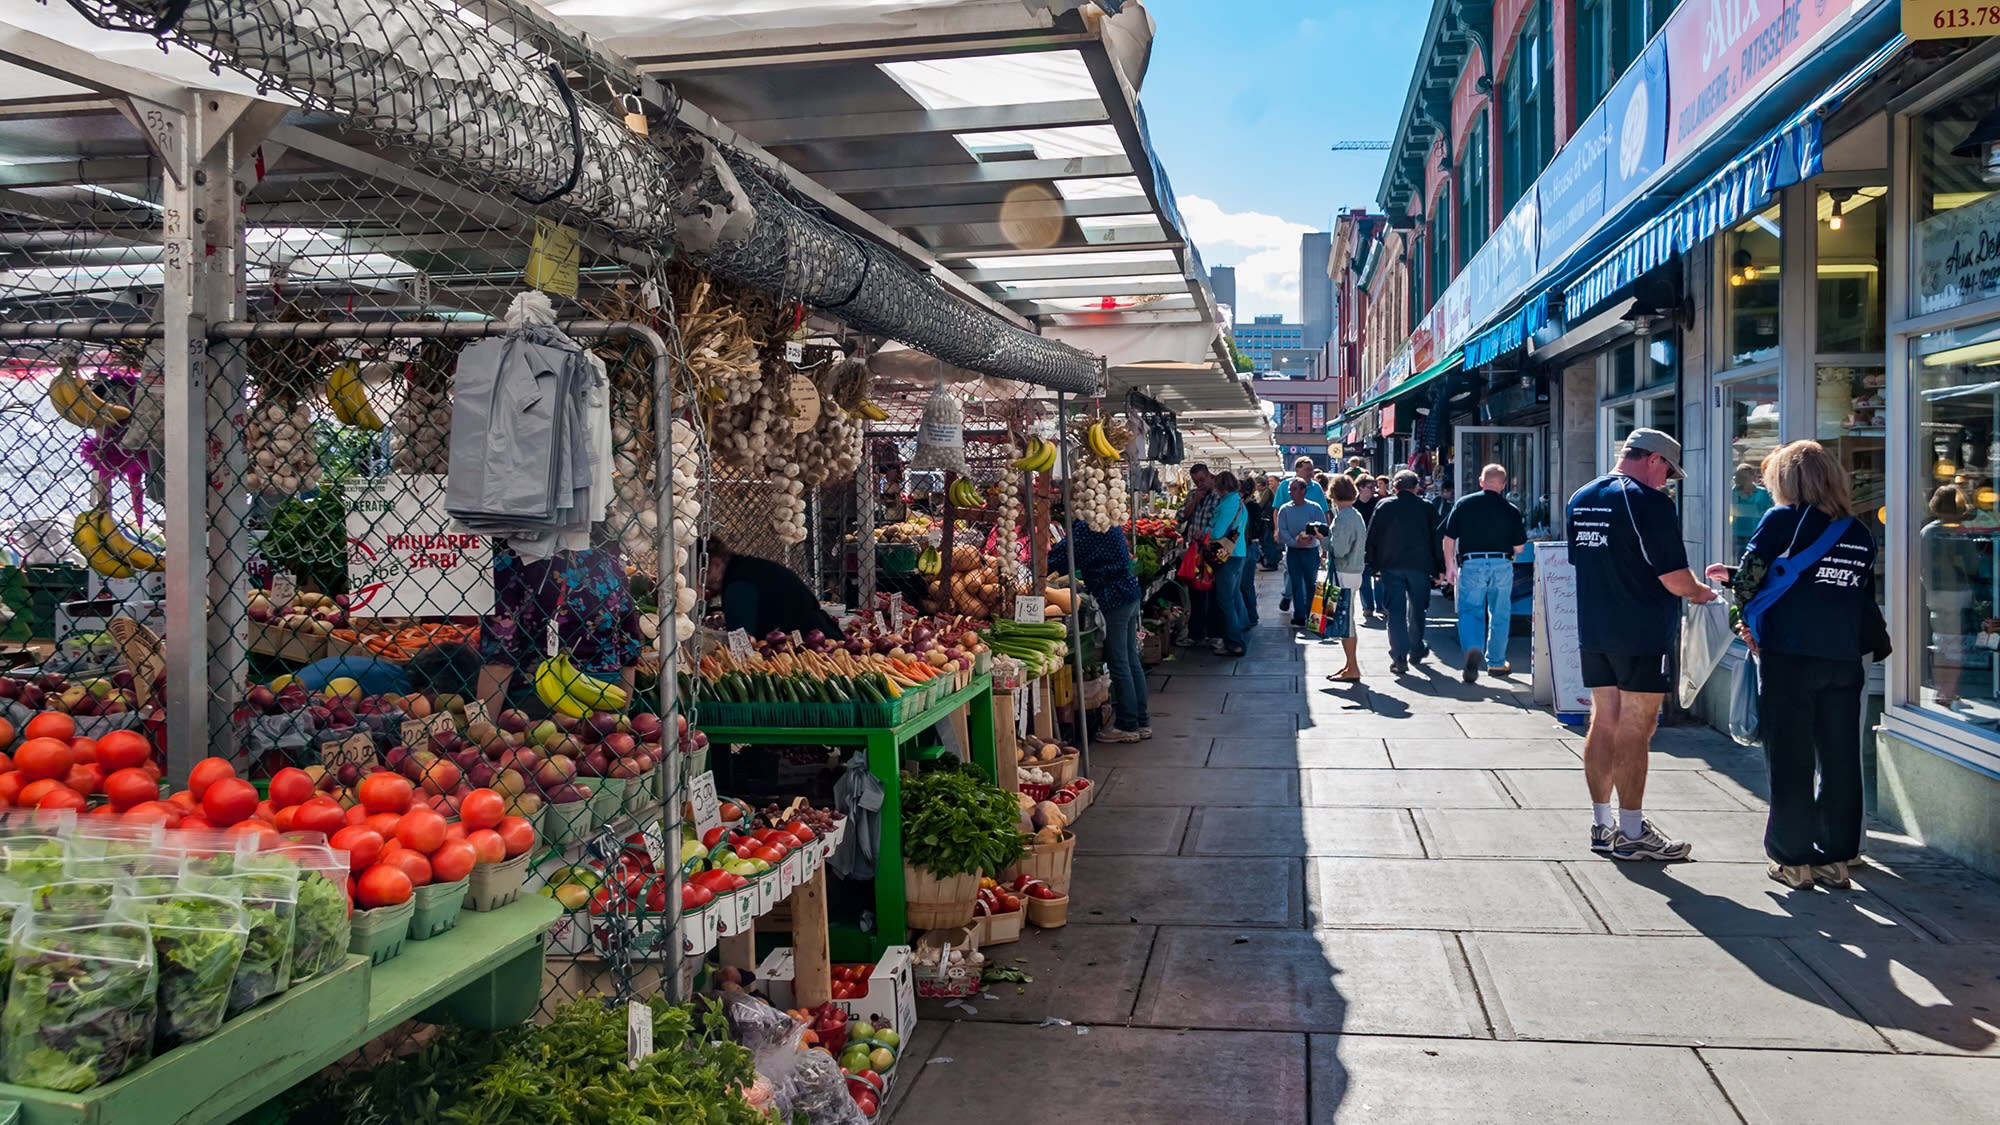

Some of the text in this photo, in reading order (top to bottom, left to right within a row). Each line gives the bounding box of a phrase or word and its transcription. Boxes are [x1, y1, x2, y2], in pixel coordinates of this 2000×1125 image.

[1678, 65, 1730, 145] BOULANGERIE
[1740, 2, 1801, 88] PATISSERIE
[147, 111, 164, 131] 53
[1553, 175, 1573, 204] House
[1582, 123, 1614, 172] Cheese
[189, 339, 204, 355] 53
[386, 534, 480, 550] RHUBARBE
[1576, 531, 1600, 541] ARMY
[1815, 567, 1854, 581] ARMY
